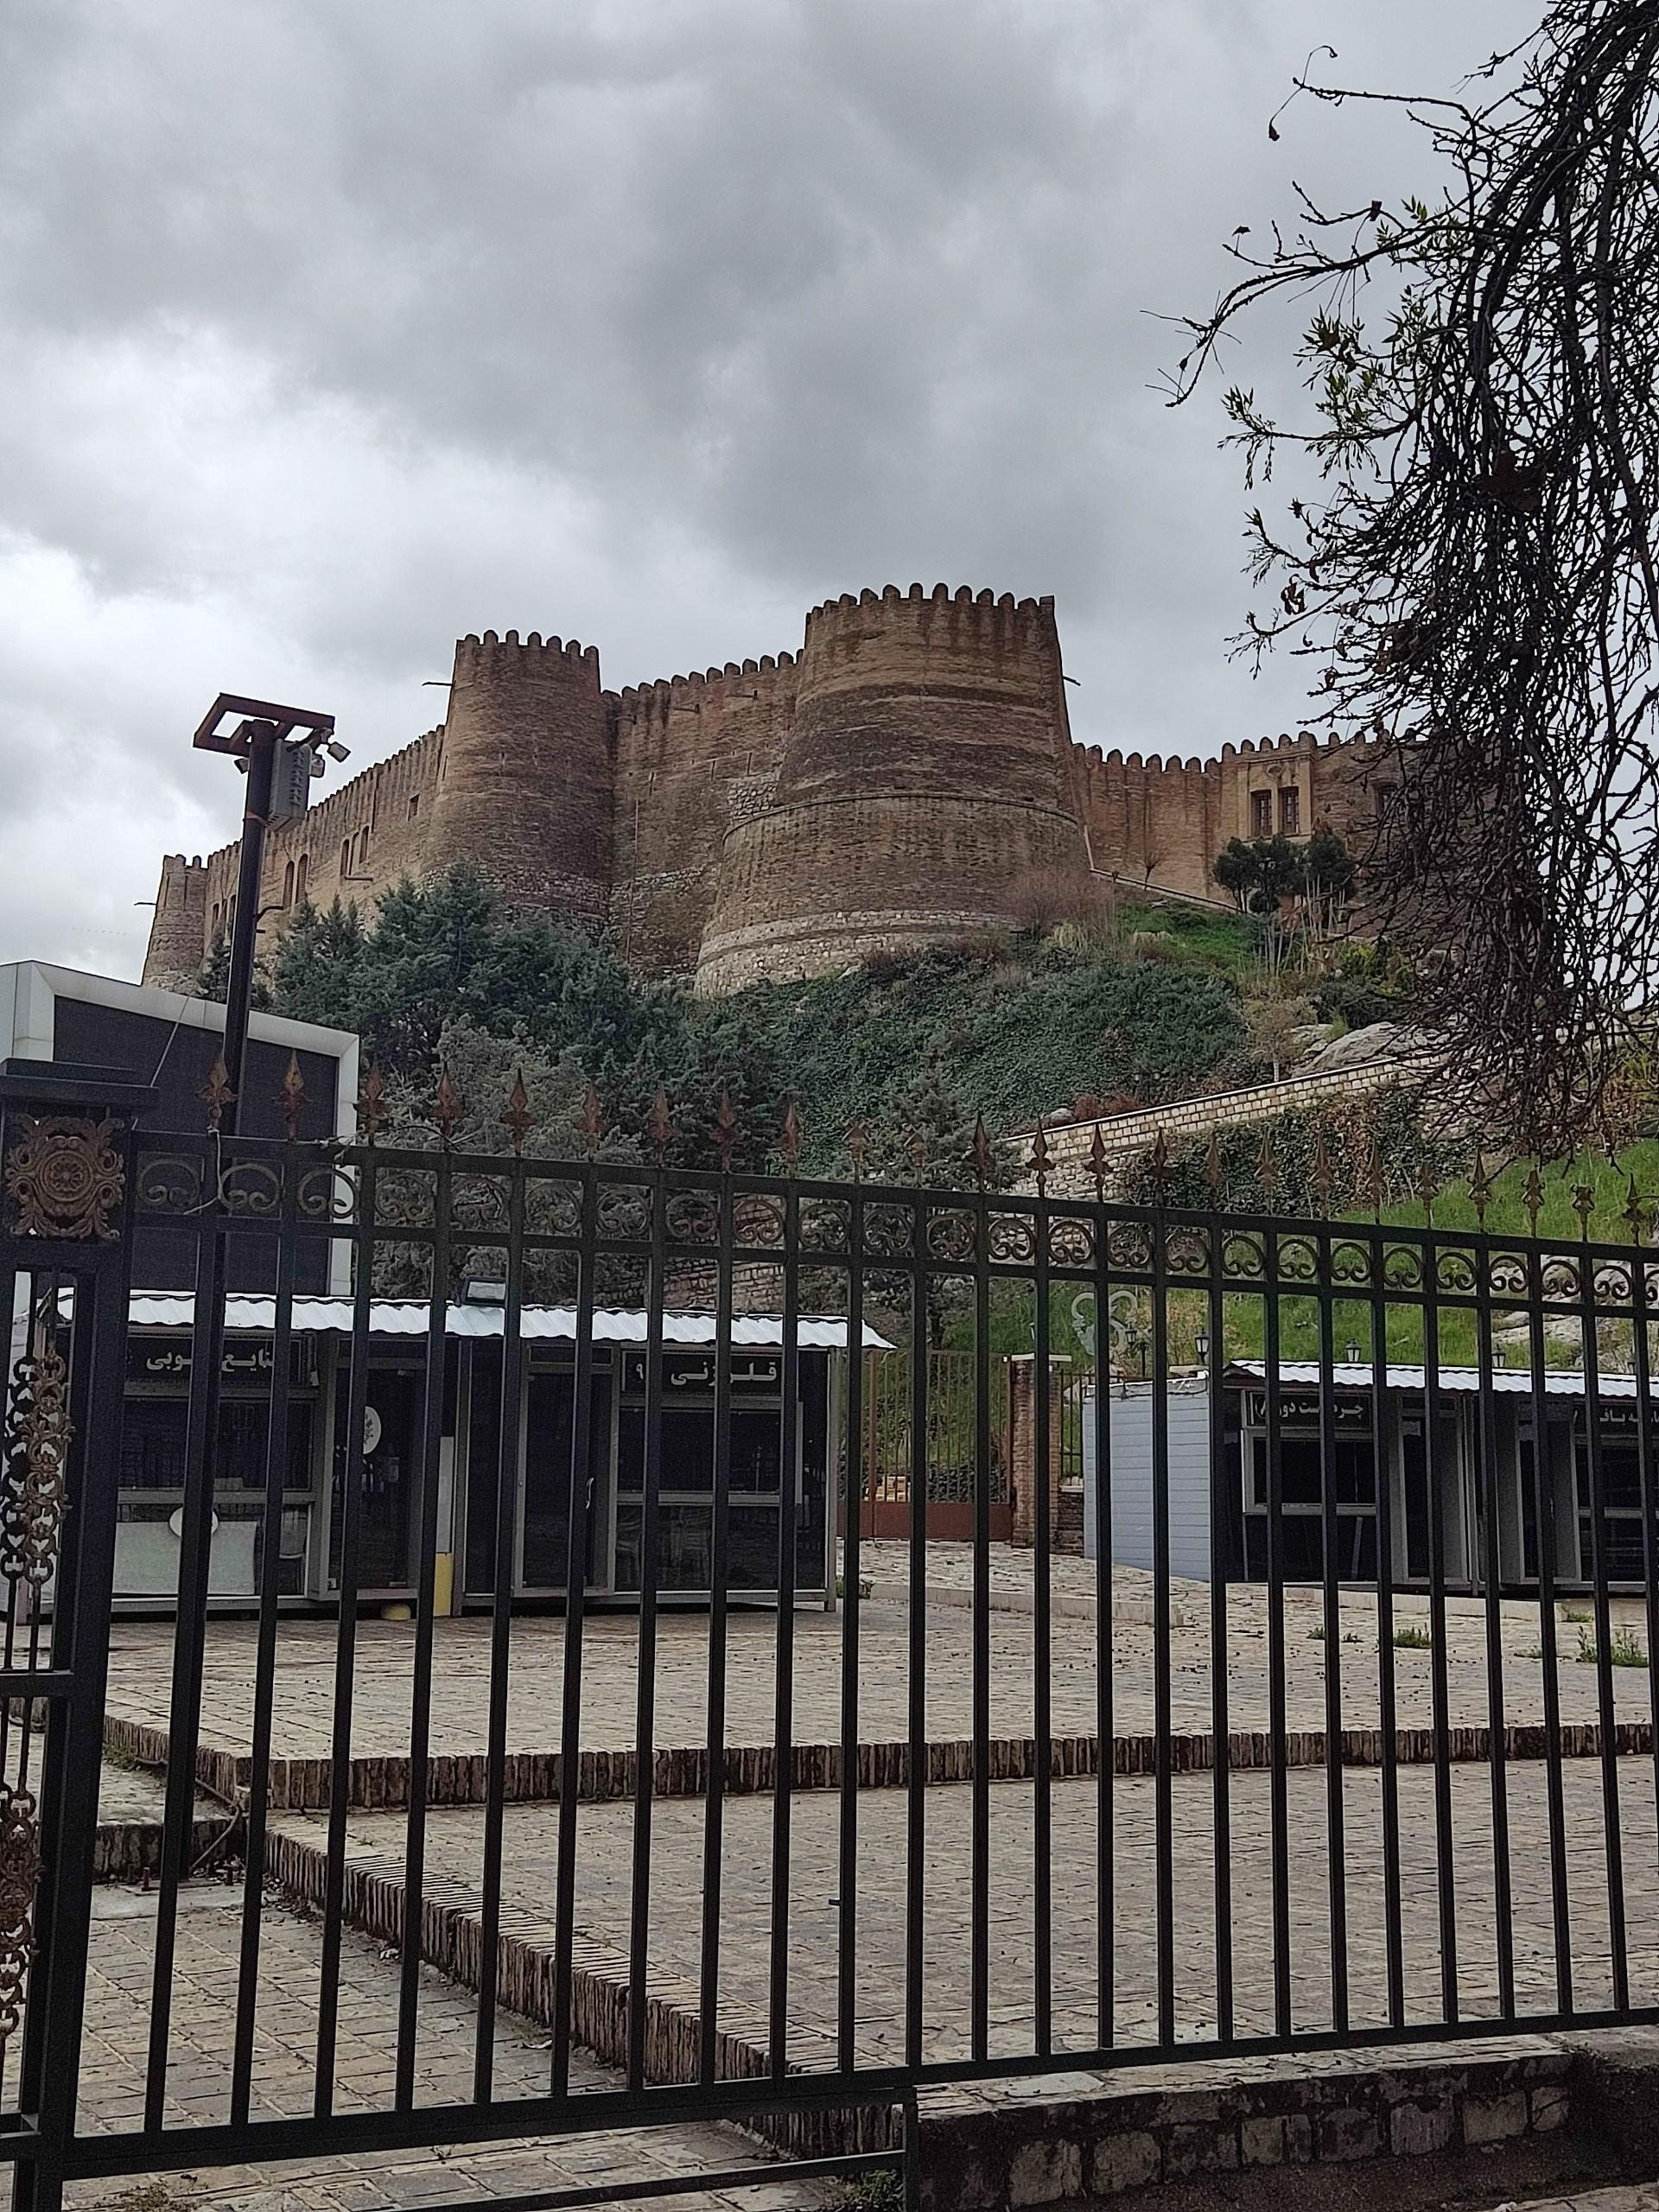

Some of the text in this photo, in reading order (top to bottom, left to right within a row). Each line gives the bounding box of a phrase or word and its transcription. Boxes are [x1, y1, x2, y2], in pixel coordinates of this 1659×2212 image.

[146, 1348, 274, 1372] نایع وبی
[1299, 1402, 1320, 1414] ست
[1599, 1408, 1625, 1426] باف
